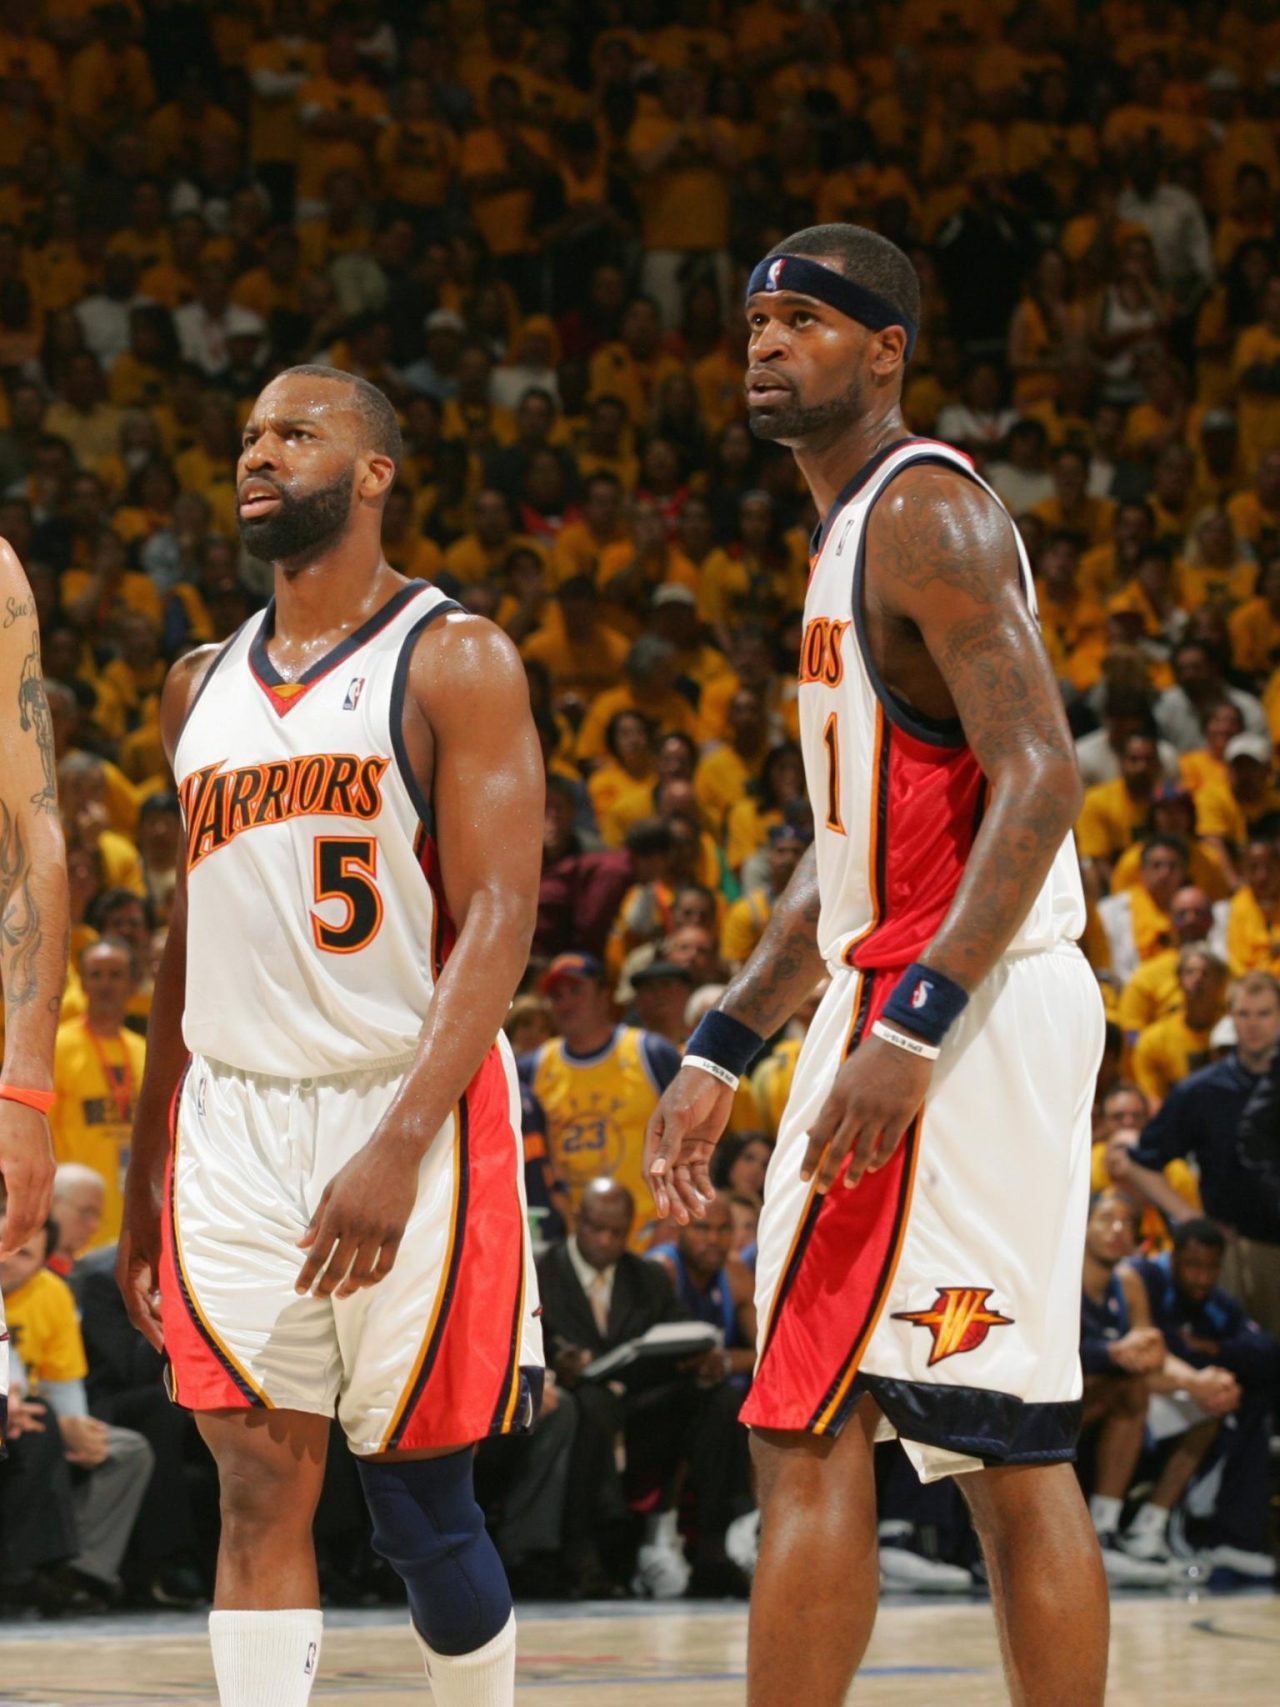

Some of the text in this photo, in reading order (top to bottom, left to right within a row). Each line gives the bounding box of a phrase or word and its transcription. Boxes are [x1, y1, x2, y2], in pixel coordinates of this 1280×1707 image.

[823, 711, 848, 837] 1
[310, 836, 384, 955] 5
[563, 1121, 605, 1153] 23
